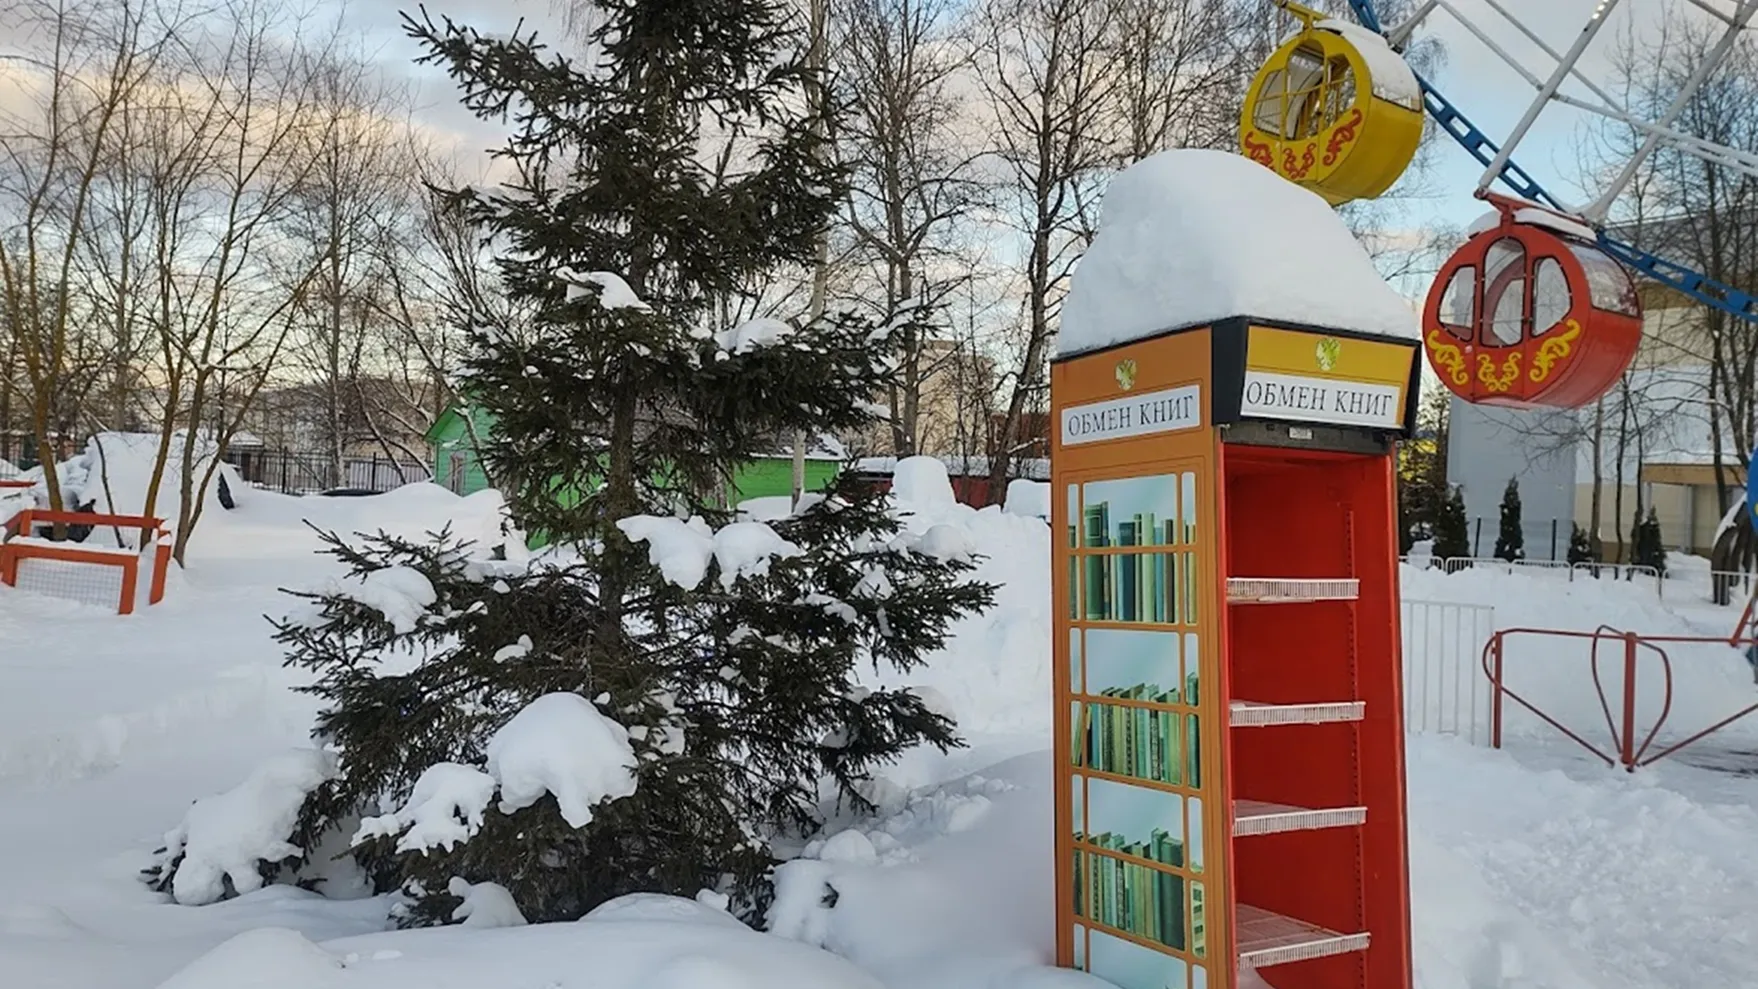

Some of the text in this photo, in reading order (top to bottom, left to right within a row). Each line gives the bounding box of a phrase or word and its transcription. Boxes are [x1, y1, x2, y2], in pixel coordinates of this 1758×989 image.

[1068, 395, 1193, 436] ОБМЕН КНИГ
[1246, 381, 1393, 417] ОБМЕН КНИГ
